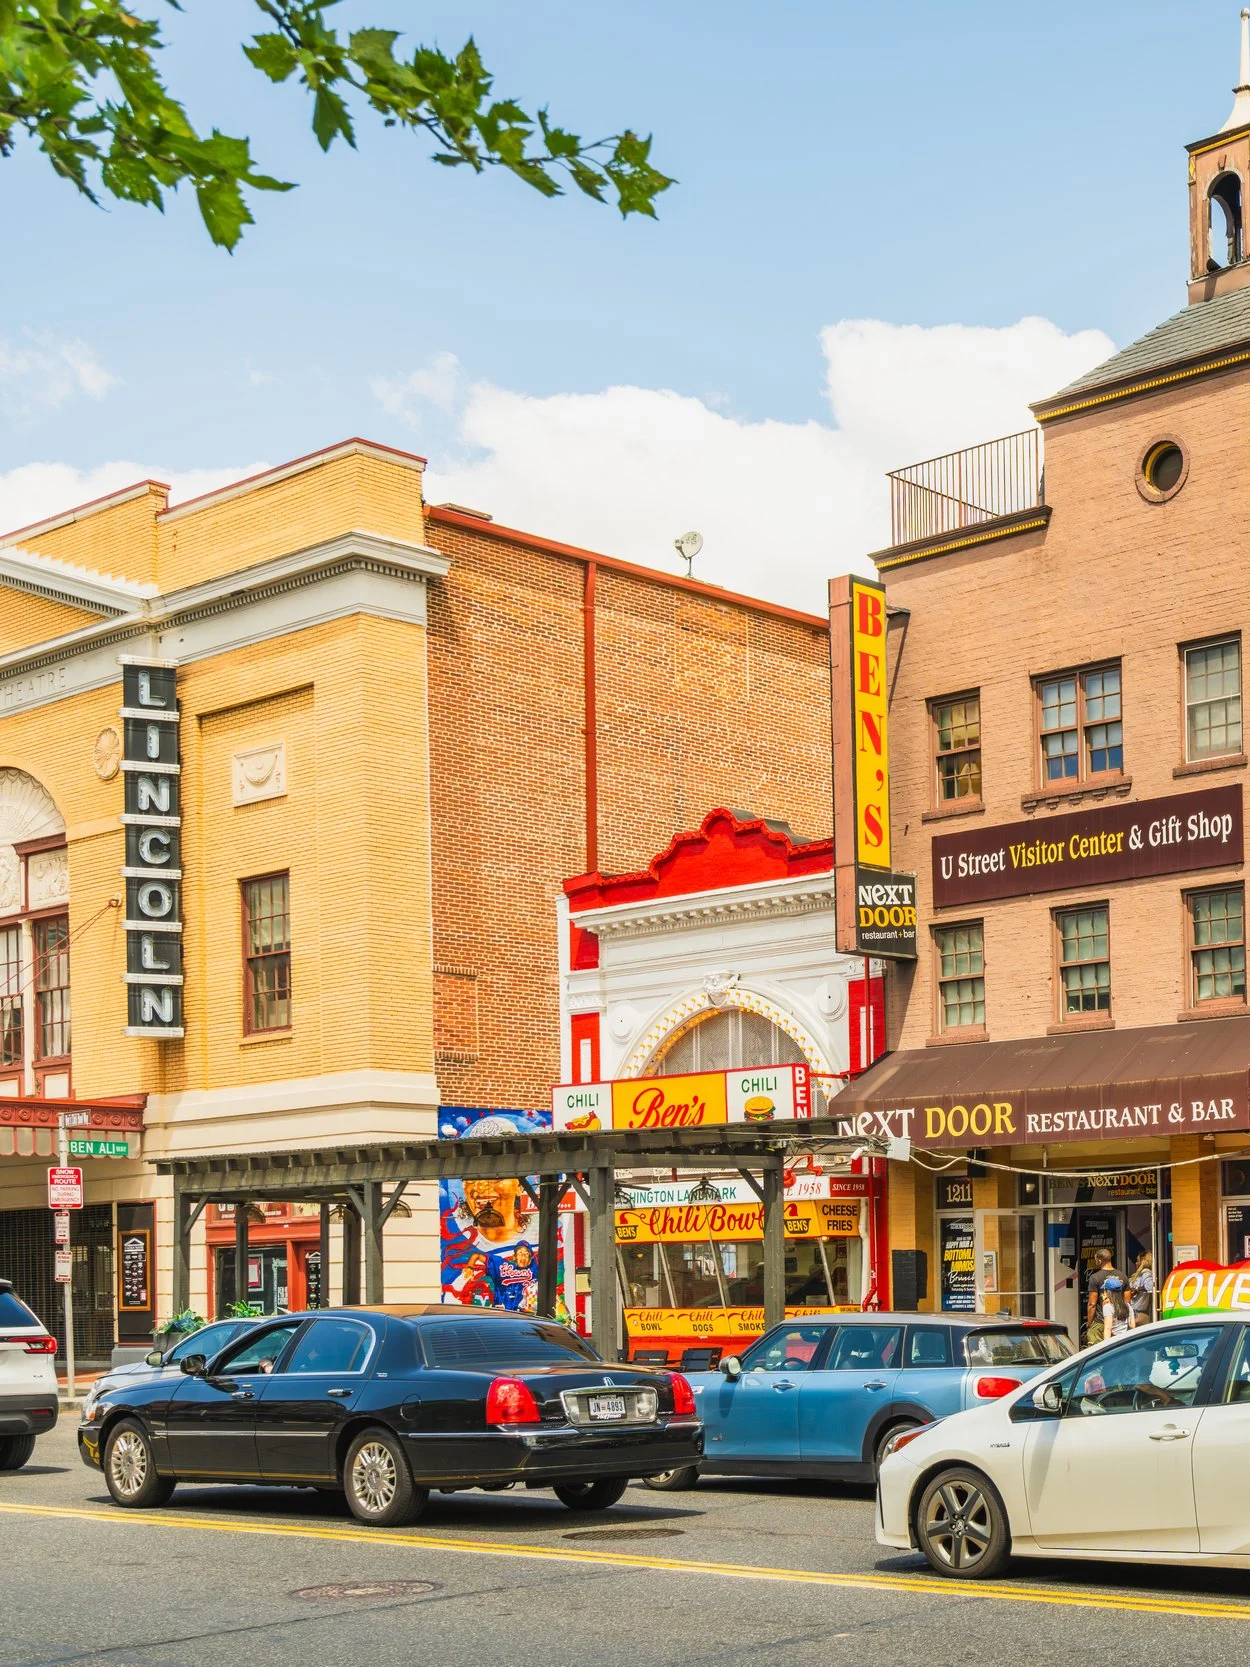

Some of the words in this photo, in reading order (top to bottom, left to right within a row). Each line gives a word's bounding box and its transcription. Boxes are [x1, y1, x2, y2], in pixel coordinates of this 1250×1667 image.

[0, 666, 66, 705] HEATRE
[856, 591, 884, 846] BEN'S
[137, 669, 174, 1024] LINCOLN
[941, 856, 953, 880] U
[958, 848, 1006, 878] Street
[1009, 840, 1065, 869] Visitor
[1069, 832, 1124, 860] Center
[1128, 825, 1144, 850] &
[1148, 815, 1182, 847] Gift
[1187, 811, 1233, 843] Shop
[859, 906, 917, 928] DOOR
[740, 1076, 778, 1093] CHILI
[566, 1092, 600, 1109] CHILI
[629, 1087, 706, 1129] Ben's
[925, 1102, 1016, 1138] DOOR
[1027, 1105, 1162, 1133] RESTAURANT
[1167, 1103, 1186, 1123] &
[1191, 1099, 1236, 1121] BAR
[70, 1141, 94, 1153] BEN
[99, 1143, 116, 1154] ALI
[798, 1183, 822, 1196] 1958
[831, 1183, 852, 1191] SINCE
[852, 1183, 865, 1191] 1958
[946, 1184, 972, 1202] 1211
[822, 1204, 858, 1216] CHEESE
[649, 1205, 702, 1236] Chili
[787, 1219, 808, 1231] BEN'S
[827, 1219, 853, 1231] FRIES
[616, 1226, 636, 1238] BEN'S
[639, 1311, 663, 1322] Chili
[689, 1311, 714, 1321] Chili
[641, 1322, 663, 1331] BOWL
[692, 1323, 714, 1332] DOGS
[592, 1402, 601, 1412] JN
[606, 1401, 623, 1413] 4893
